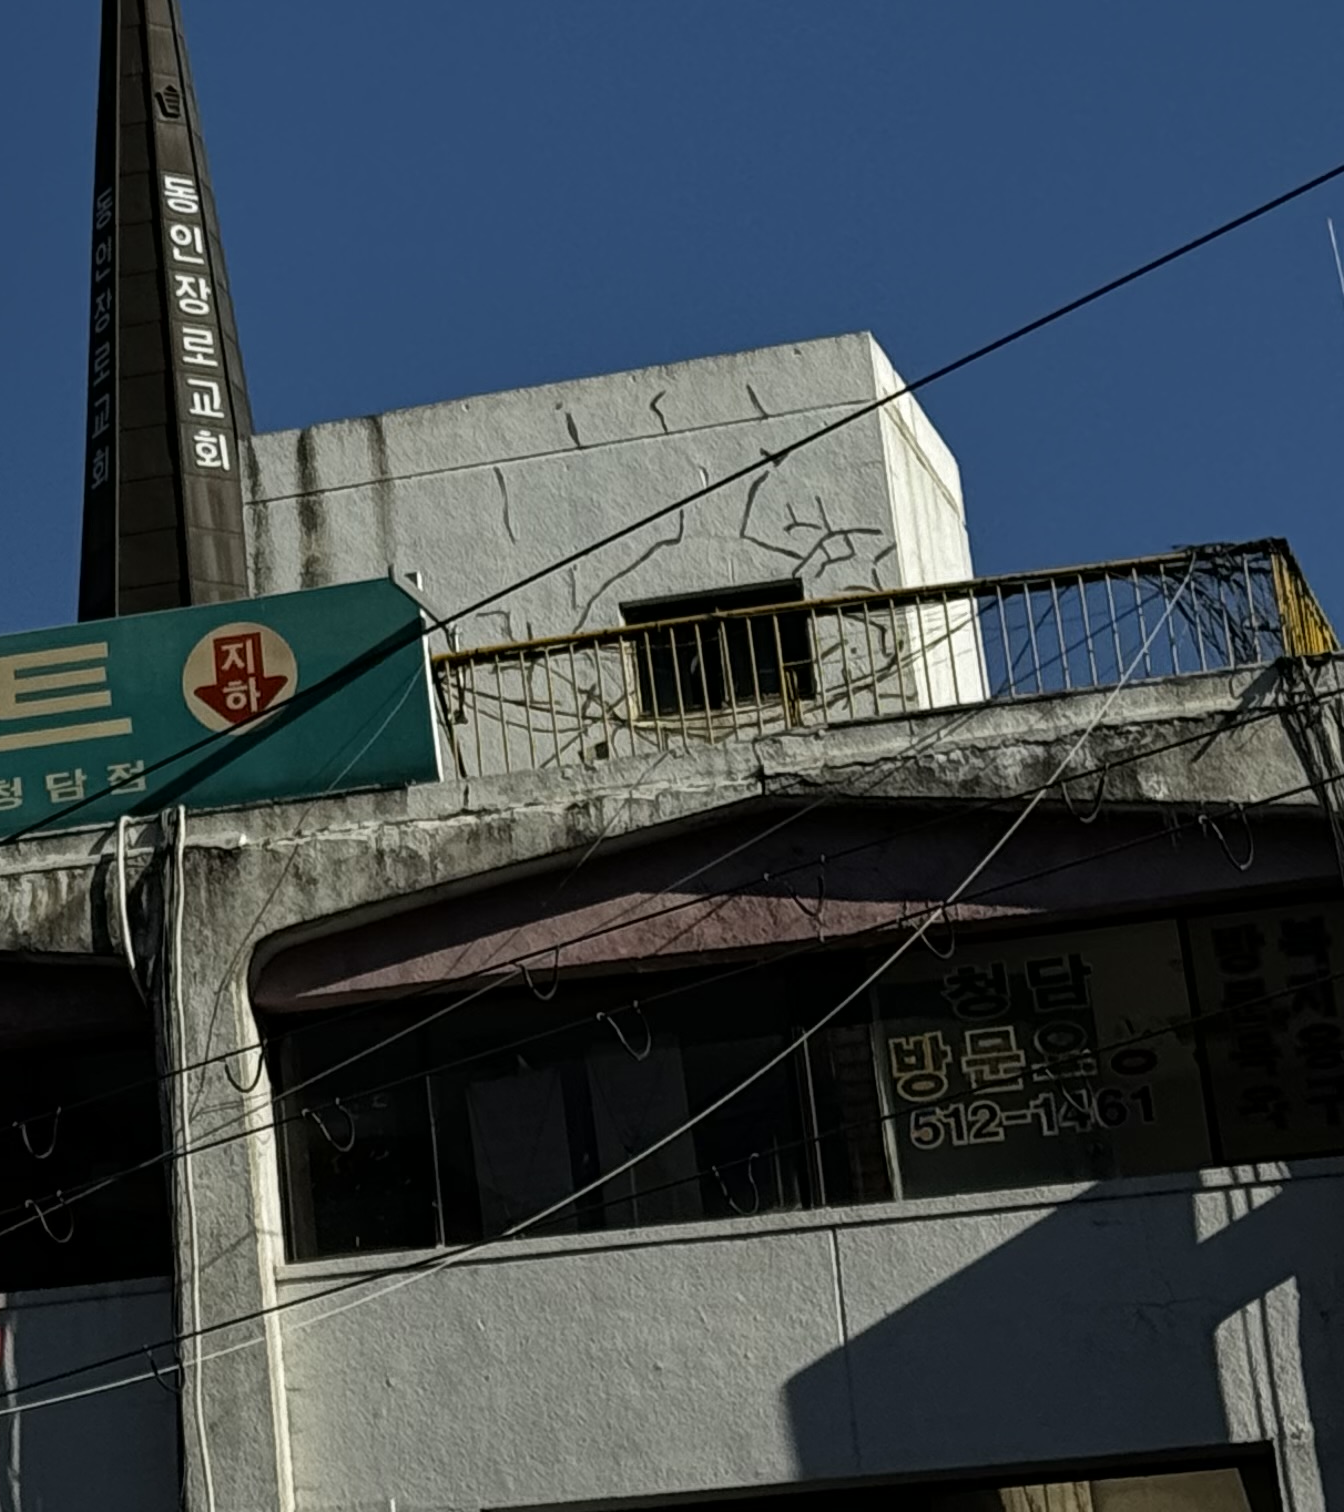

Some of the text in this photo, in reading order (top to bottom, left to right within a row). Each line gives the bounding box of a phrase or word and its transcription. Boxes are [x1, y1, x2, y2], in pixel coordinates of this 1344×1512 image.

[163, 174, 230, 471] 동인장로교회
[221, 639, 261, 712] 지하
[942, 953, 1092, 1020] 청담
[910, 1086, 1155, 1150] 512-1461
